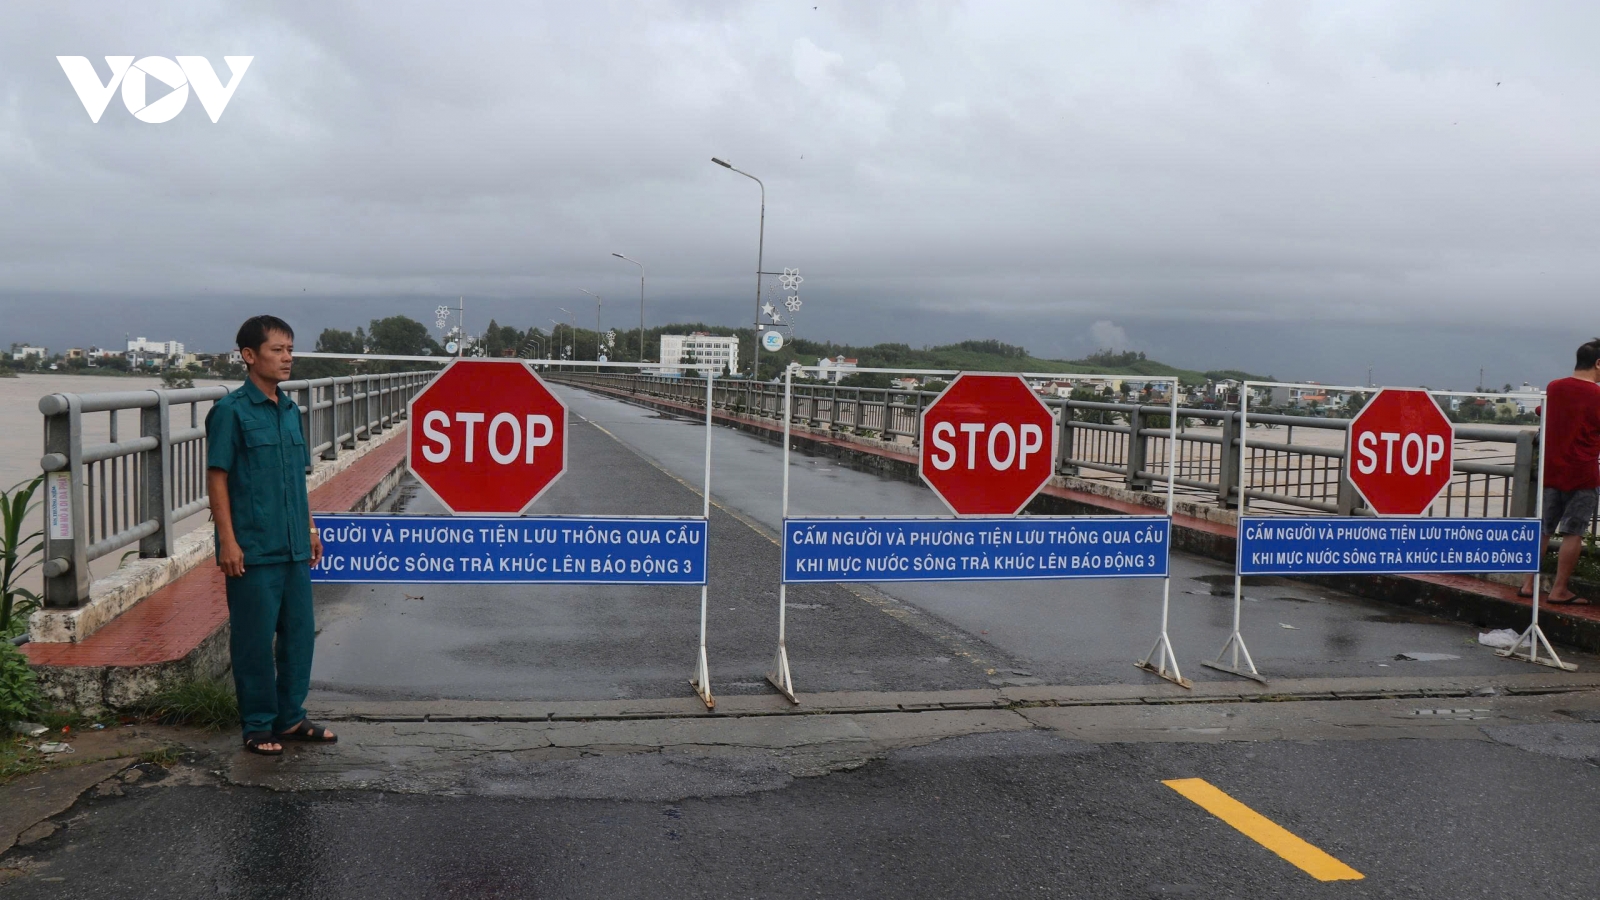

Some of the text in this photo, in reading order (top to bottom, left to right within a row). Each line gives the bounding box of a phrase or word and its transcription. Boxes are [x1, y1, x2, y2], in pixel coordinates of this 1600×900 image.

[422, 410, 554, 465] STOP
[931, 421, 1043, 471] STOP
[1357, 430, 1445, 475] STOP
[318, 522, 699, 546] GƯỜI VÀ PHƯƠNG TIỆN LƯU THÔNG QUA CẦU
[793, 526, 1162, 547] CẤM NGƯỜI VÀ PHƯƠNG TIỆN LƯU THÔNG QUA CẦU
[1247, 523, 1533, 543] CẤM NGƯỜI VÀ PHƯƠNG TIỆN LƯU THÔNG QUA CẦU
[311, 552, 691, 576] ỰC NƯỚC SÔNG TRÀ KHÚC LÊN BÁO ĐỘNG 3
[797, 552, 1154, 575] KHI MỰC NƯỚC SÔNG TRÀ KHÚC LÊN BÁO ĐỘNG 3
[1253, 548, 1531, 567] KHI MỰC NƯỚC SÔNG TRÀ KHÚC LÊN BÁO ĐỘNG 3
